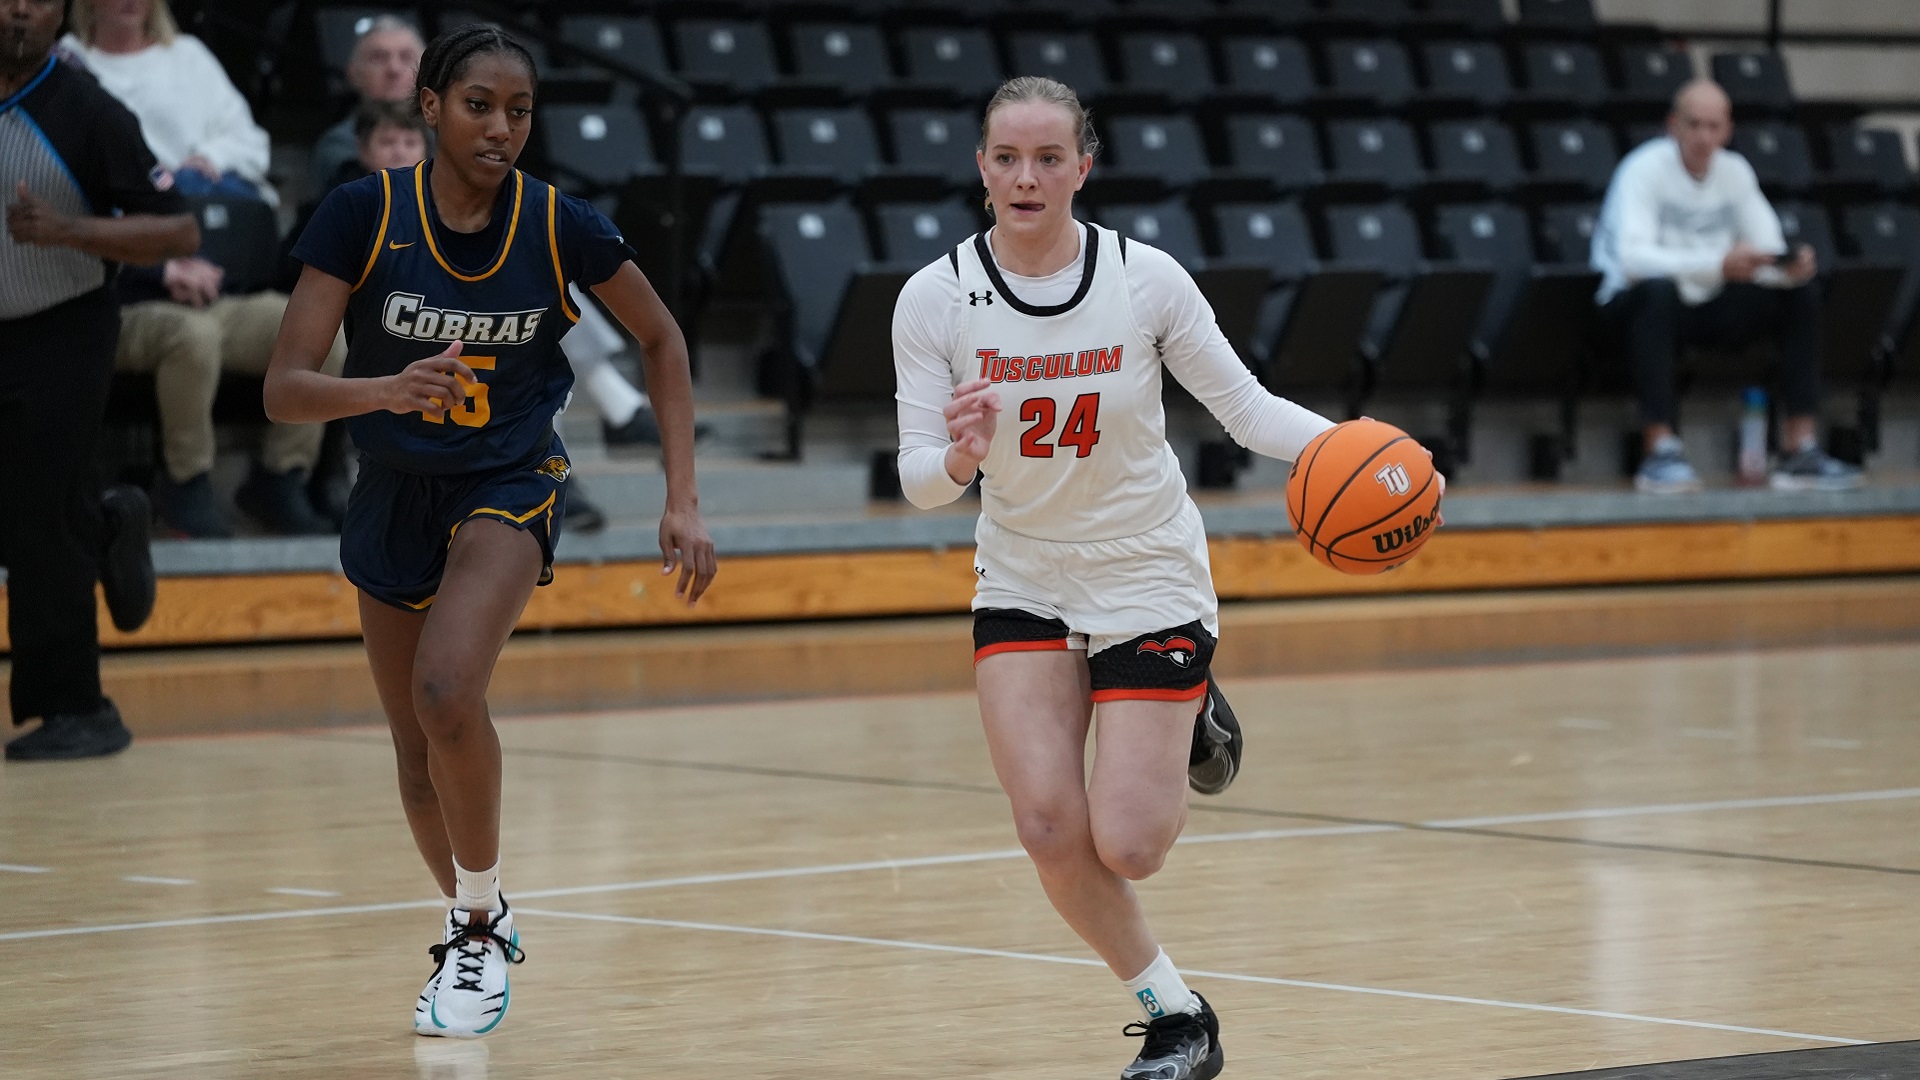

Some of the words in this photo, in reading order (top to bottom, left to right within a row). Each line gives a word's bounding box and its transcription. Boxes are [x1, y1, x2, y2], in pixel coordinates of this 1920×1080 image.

[382, 291, 548, 345] COBRAS
[976, 345, 1123, 383] TUSCULUM
[1020, 392, 1101, 458] 24
[1374, 463, 1412, 497] TU
[1371, 494, 1441, 554] Wilso
